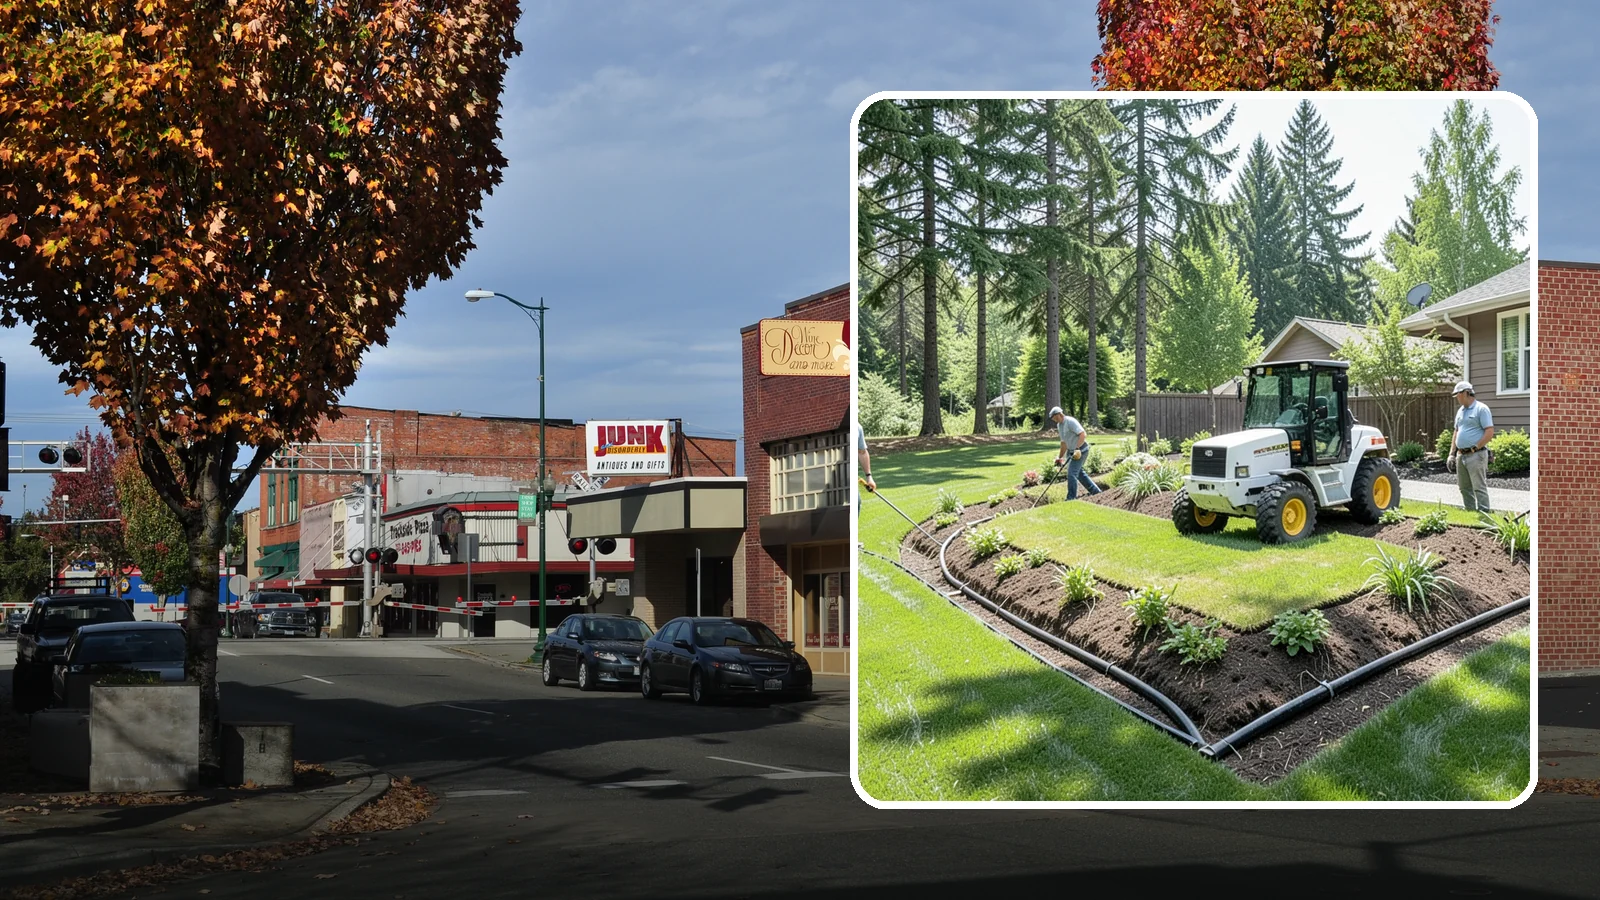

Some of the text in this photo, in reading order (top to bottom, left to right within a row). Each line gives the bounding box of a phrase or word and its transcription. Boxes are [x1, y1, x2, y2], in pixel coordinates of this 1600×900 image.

[595, 425, 666, 457] JUNK
[607, 446, 645, 454] DISORDERLY
[597, 460, 666, 470] ANTIQUES AND GIFTS
